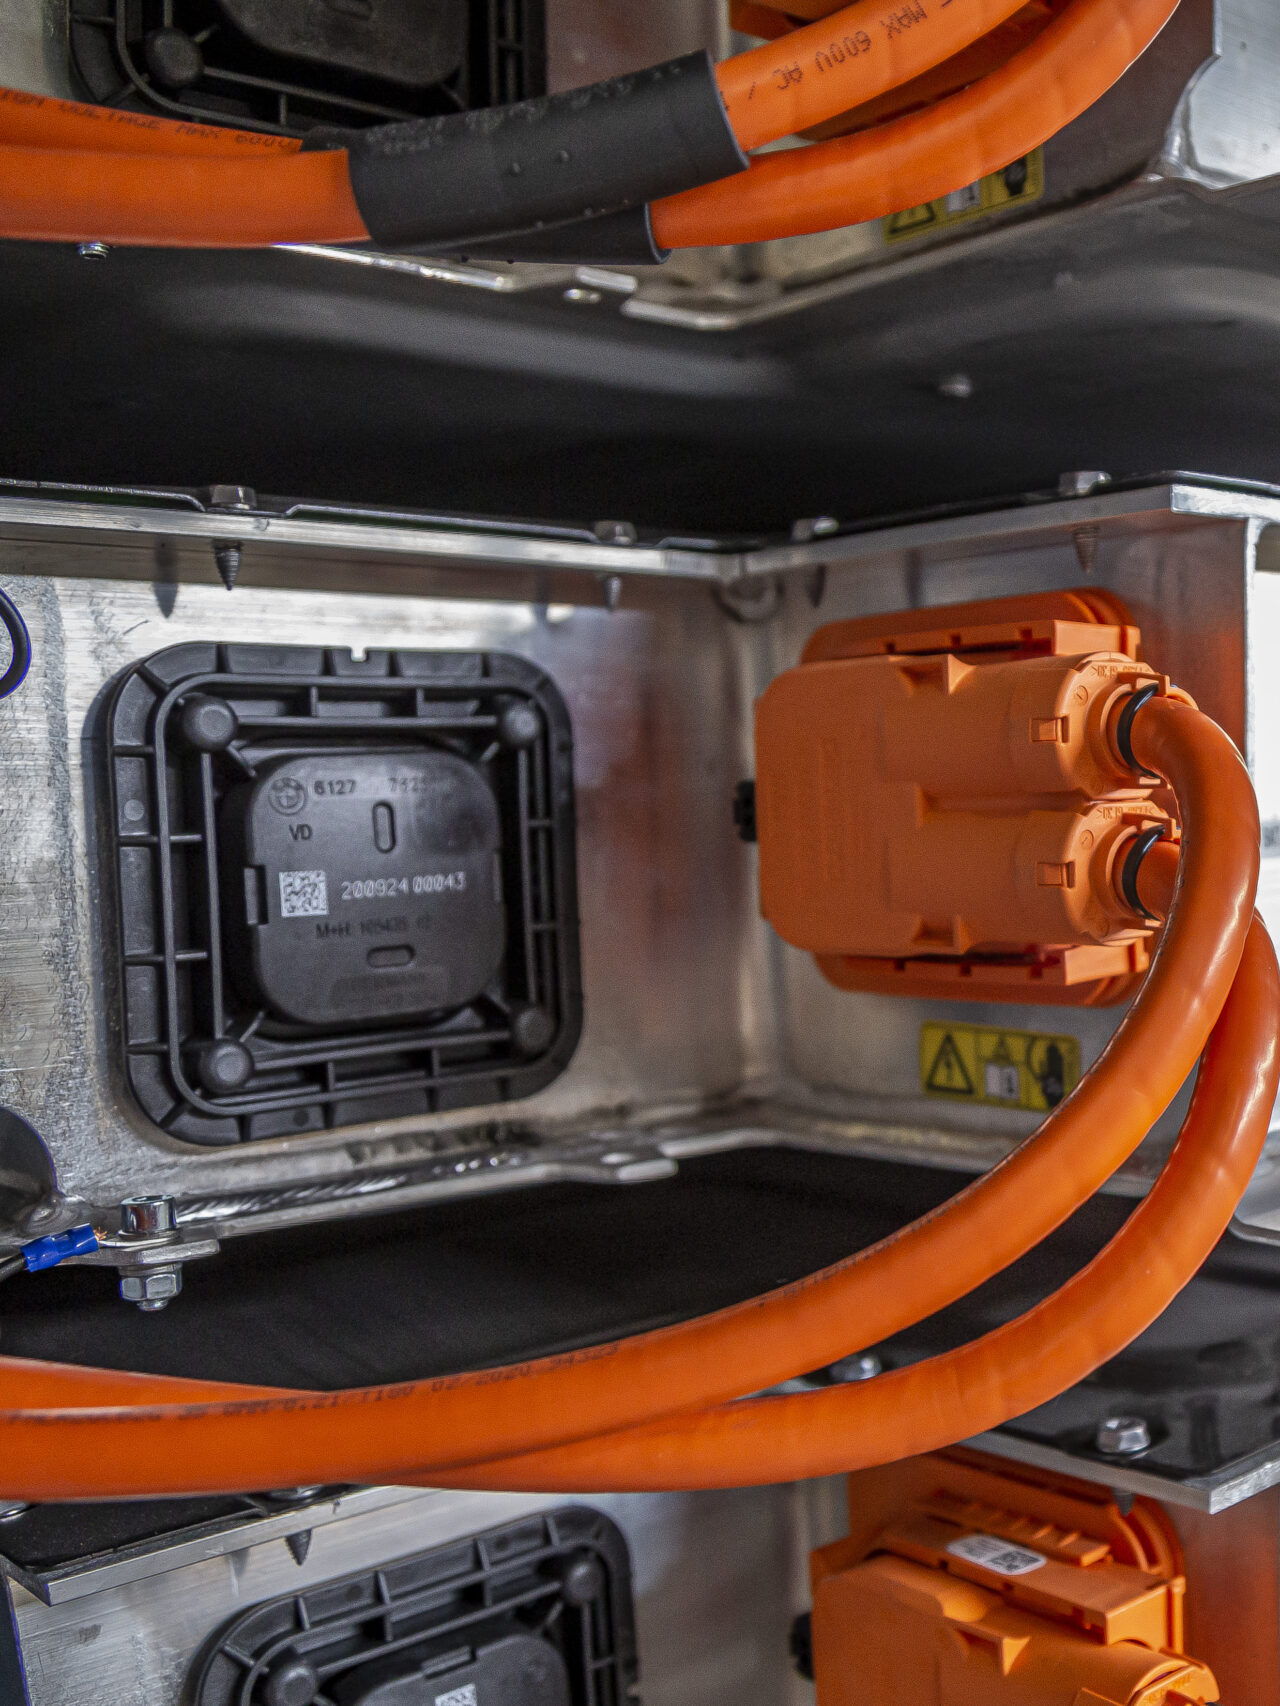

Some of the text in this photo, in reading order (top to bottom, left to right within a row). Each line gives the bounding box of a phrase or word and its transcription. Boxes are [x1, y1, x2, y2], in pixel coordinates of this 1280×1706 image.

[880, 0, 927, 39] MAX
[814, 30, 872, 73] 600V
[773, 61, 804, 91] AC
[314, 779, 357, 796] 6127
[289, 823, 313, 841] VD
[340, 871, 467, 900] 200924 00043
